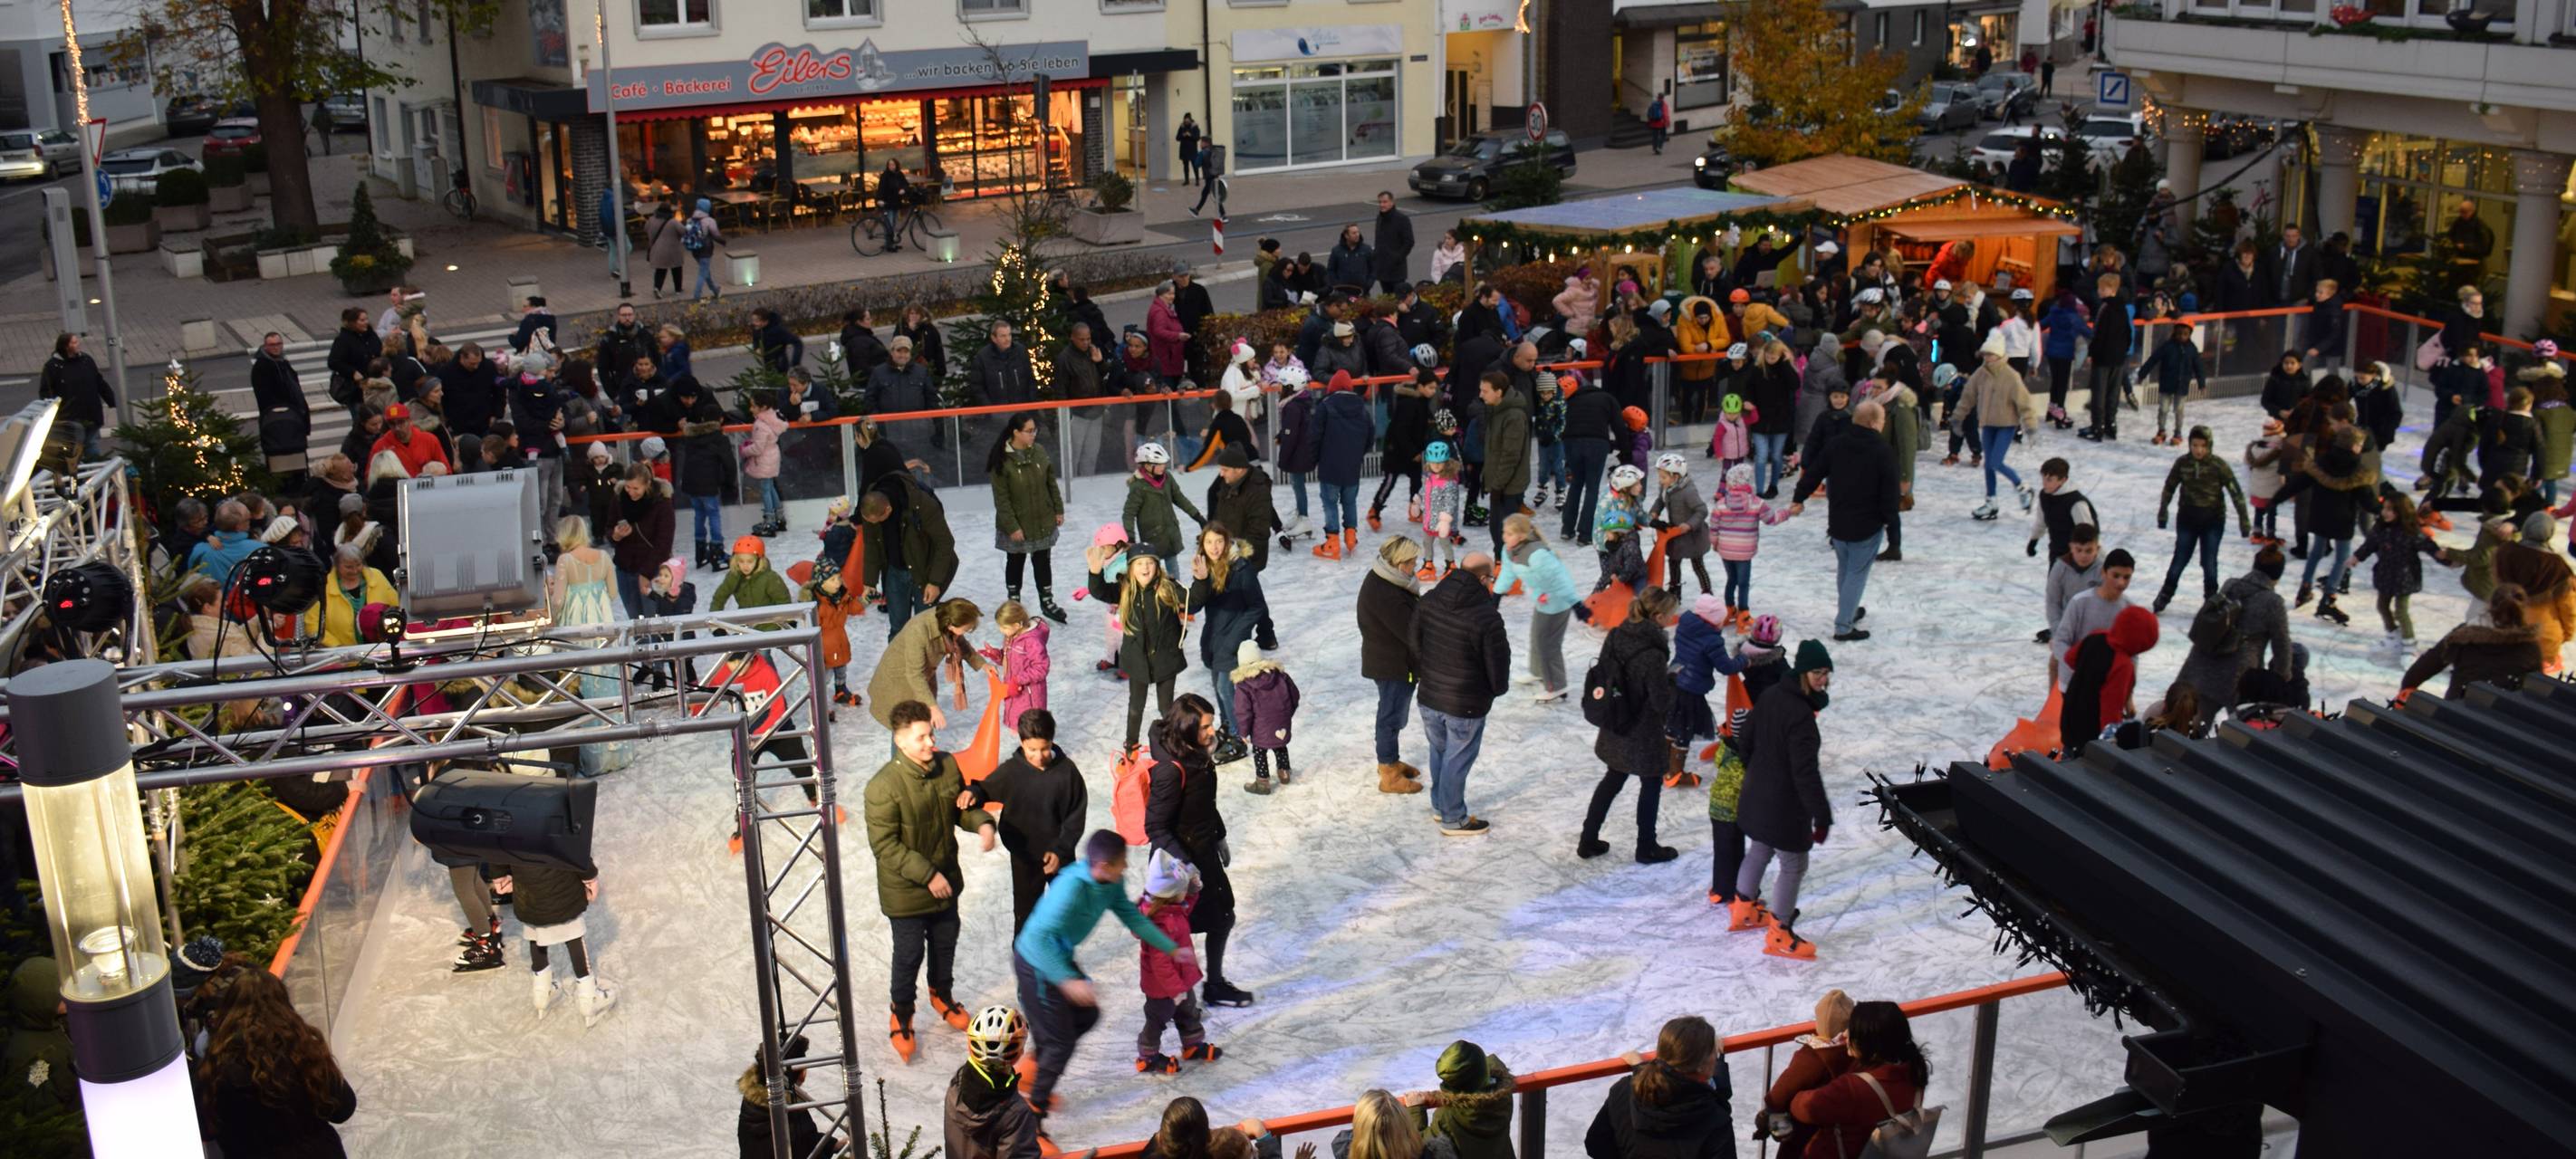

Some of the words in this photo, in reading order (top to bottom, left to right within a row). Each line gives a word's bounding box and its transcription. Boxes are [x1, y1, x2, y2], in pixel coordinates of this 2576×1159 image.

[748, 47, 851, 94] Eilers
[944, 61, 992, 76] backen
[1020, 59, 1039, 71] Sie
[1043, 57, 1079, 69] leben
[611, 81, 648, 99] Café
[664, 77, 731, 95] Bäckerei
[1531, 112, 1542, 132] 30
